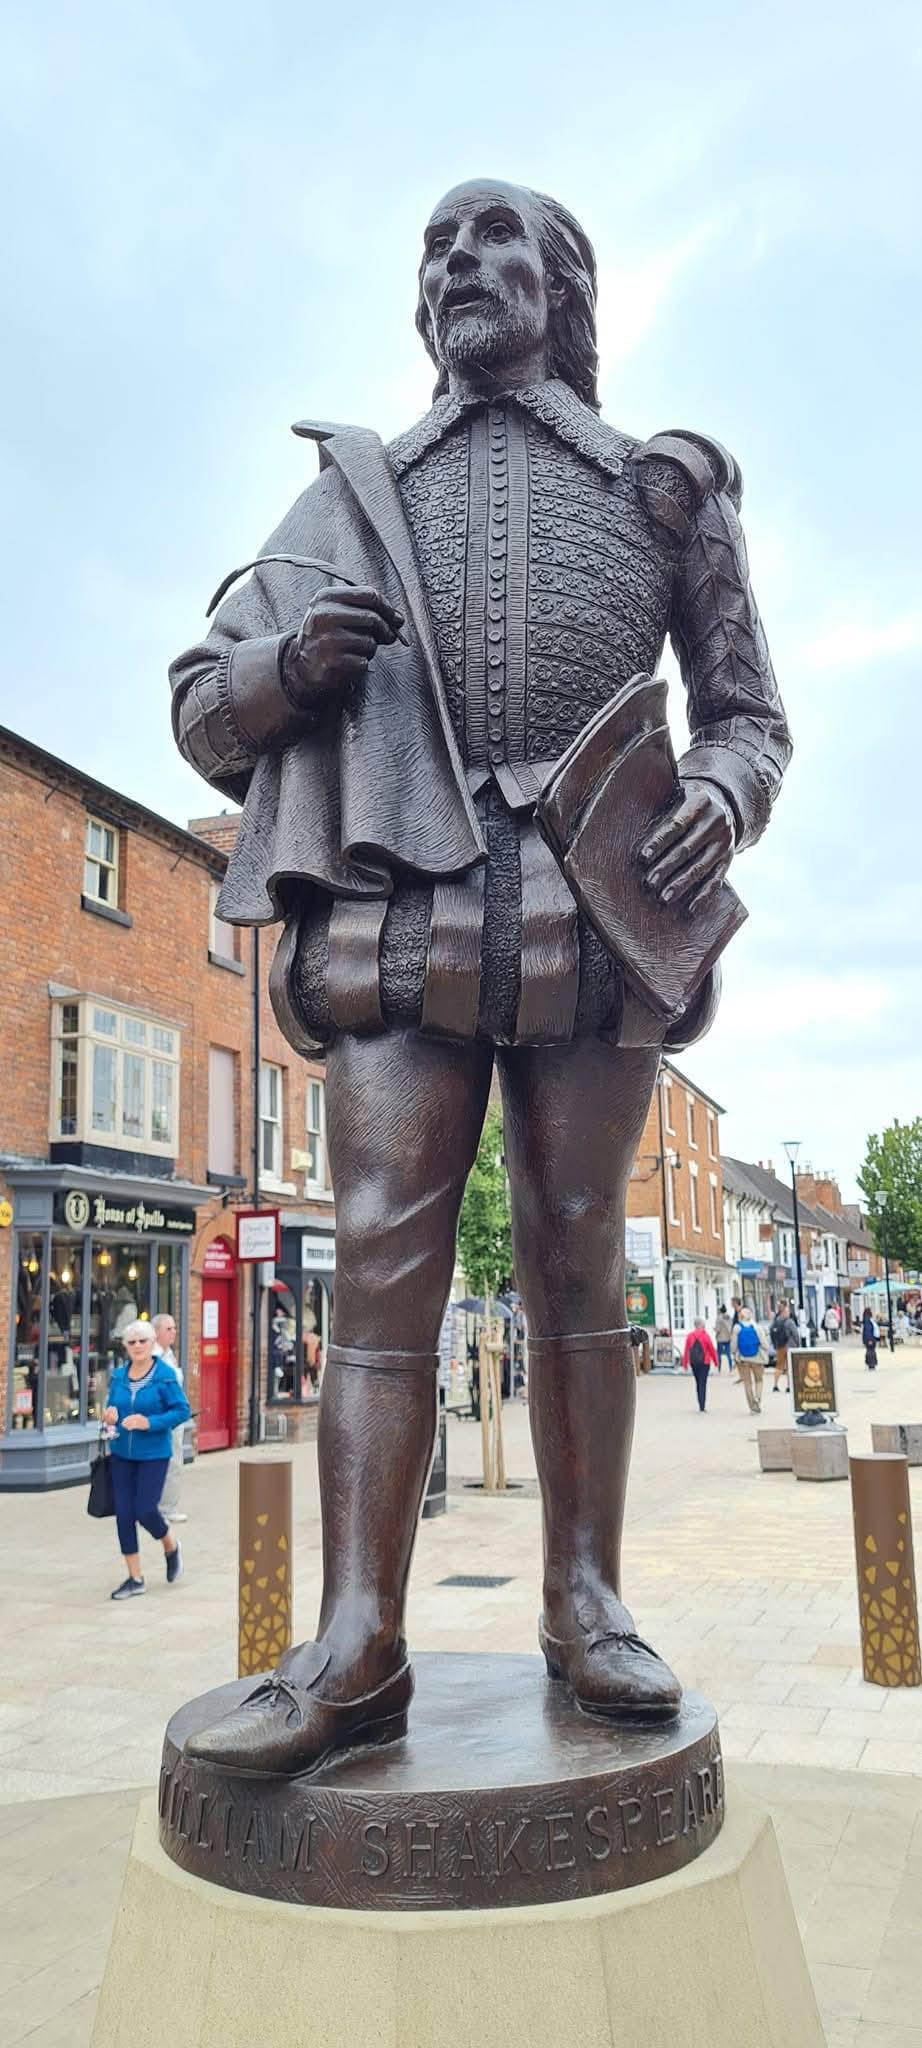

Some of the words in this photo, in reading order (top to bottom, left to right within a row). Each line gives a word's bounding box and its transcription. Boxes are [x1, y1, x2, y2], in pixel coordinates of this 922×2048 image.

[93, 1193, 125, 1228] House
[126, 1207, 136, 1224] of
[135, 1200, 165, 1233] Spells
